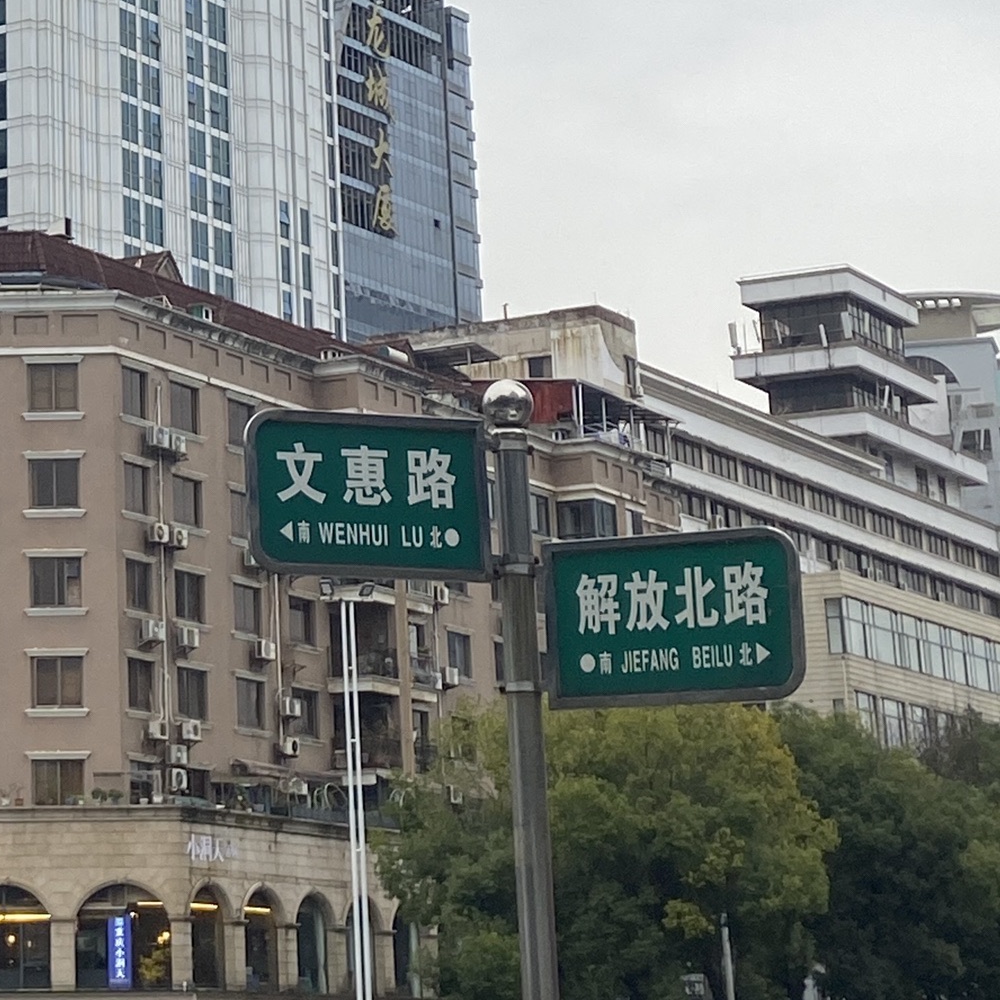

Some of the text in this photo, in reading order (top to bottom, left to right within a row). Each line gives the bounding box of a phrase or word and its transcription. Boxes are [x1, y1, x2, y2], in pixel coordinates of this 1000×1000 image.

[365, 4, 398, 236] 龙城大厦
[276, 442, 456, 509] 文惠路
[297, 520, 442, 548] 南 WENHUI LU 北
[576, 561, 768, 635] 解放北路
[599, 642, 753, 675] 南 JIEFANG BEILU 北
